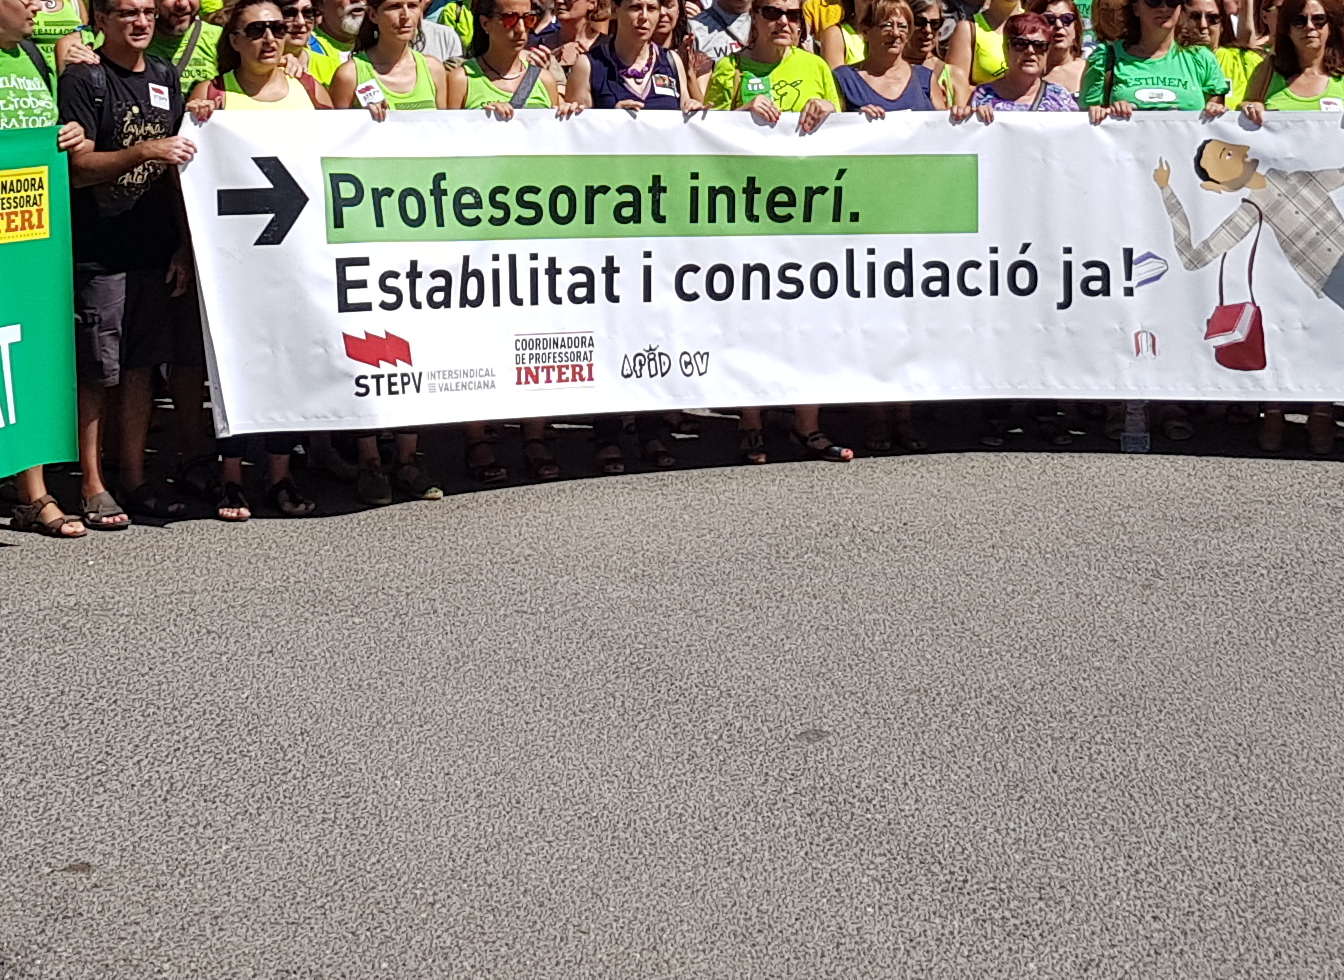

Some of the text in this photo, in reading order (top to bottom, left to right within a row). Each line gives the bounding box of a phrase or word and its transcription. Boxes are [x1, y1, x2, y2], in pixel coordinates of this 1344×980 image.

[327, 168, 860, 229] Professorat interí.
[335, 242, 1135, 313] Estabilitat i consolidació ja!
[514, 335, 595, 351] COORDINADORA
[515, 350, 594, 365] DE PROFESSORAT
[427, 367, 497, 381] INTERSINDICAL
[353, 371, 423, 398] STEPV
[438, 381, 497, 393] VALENCIANA
